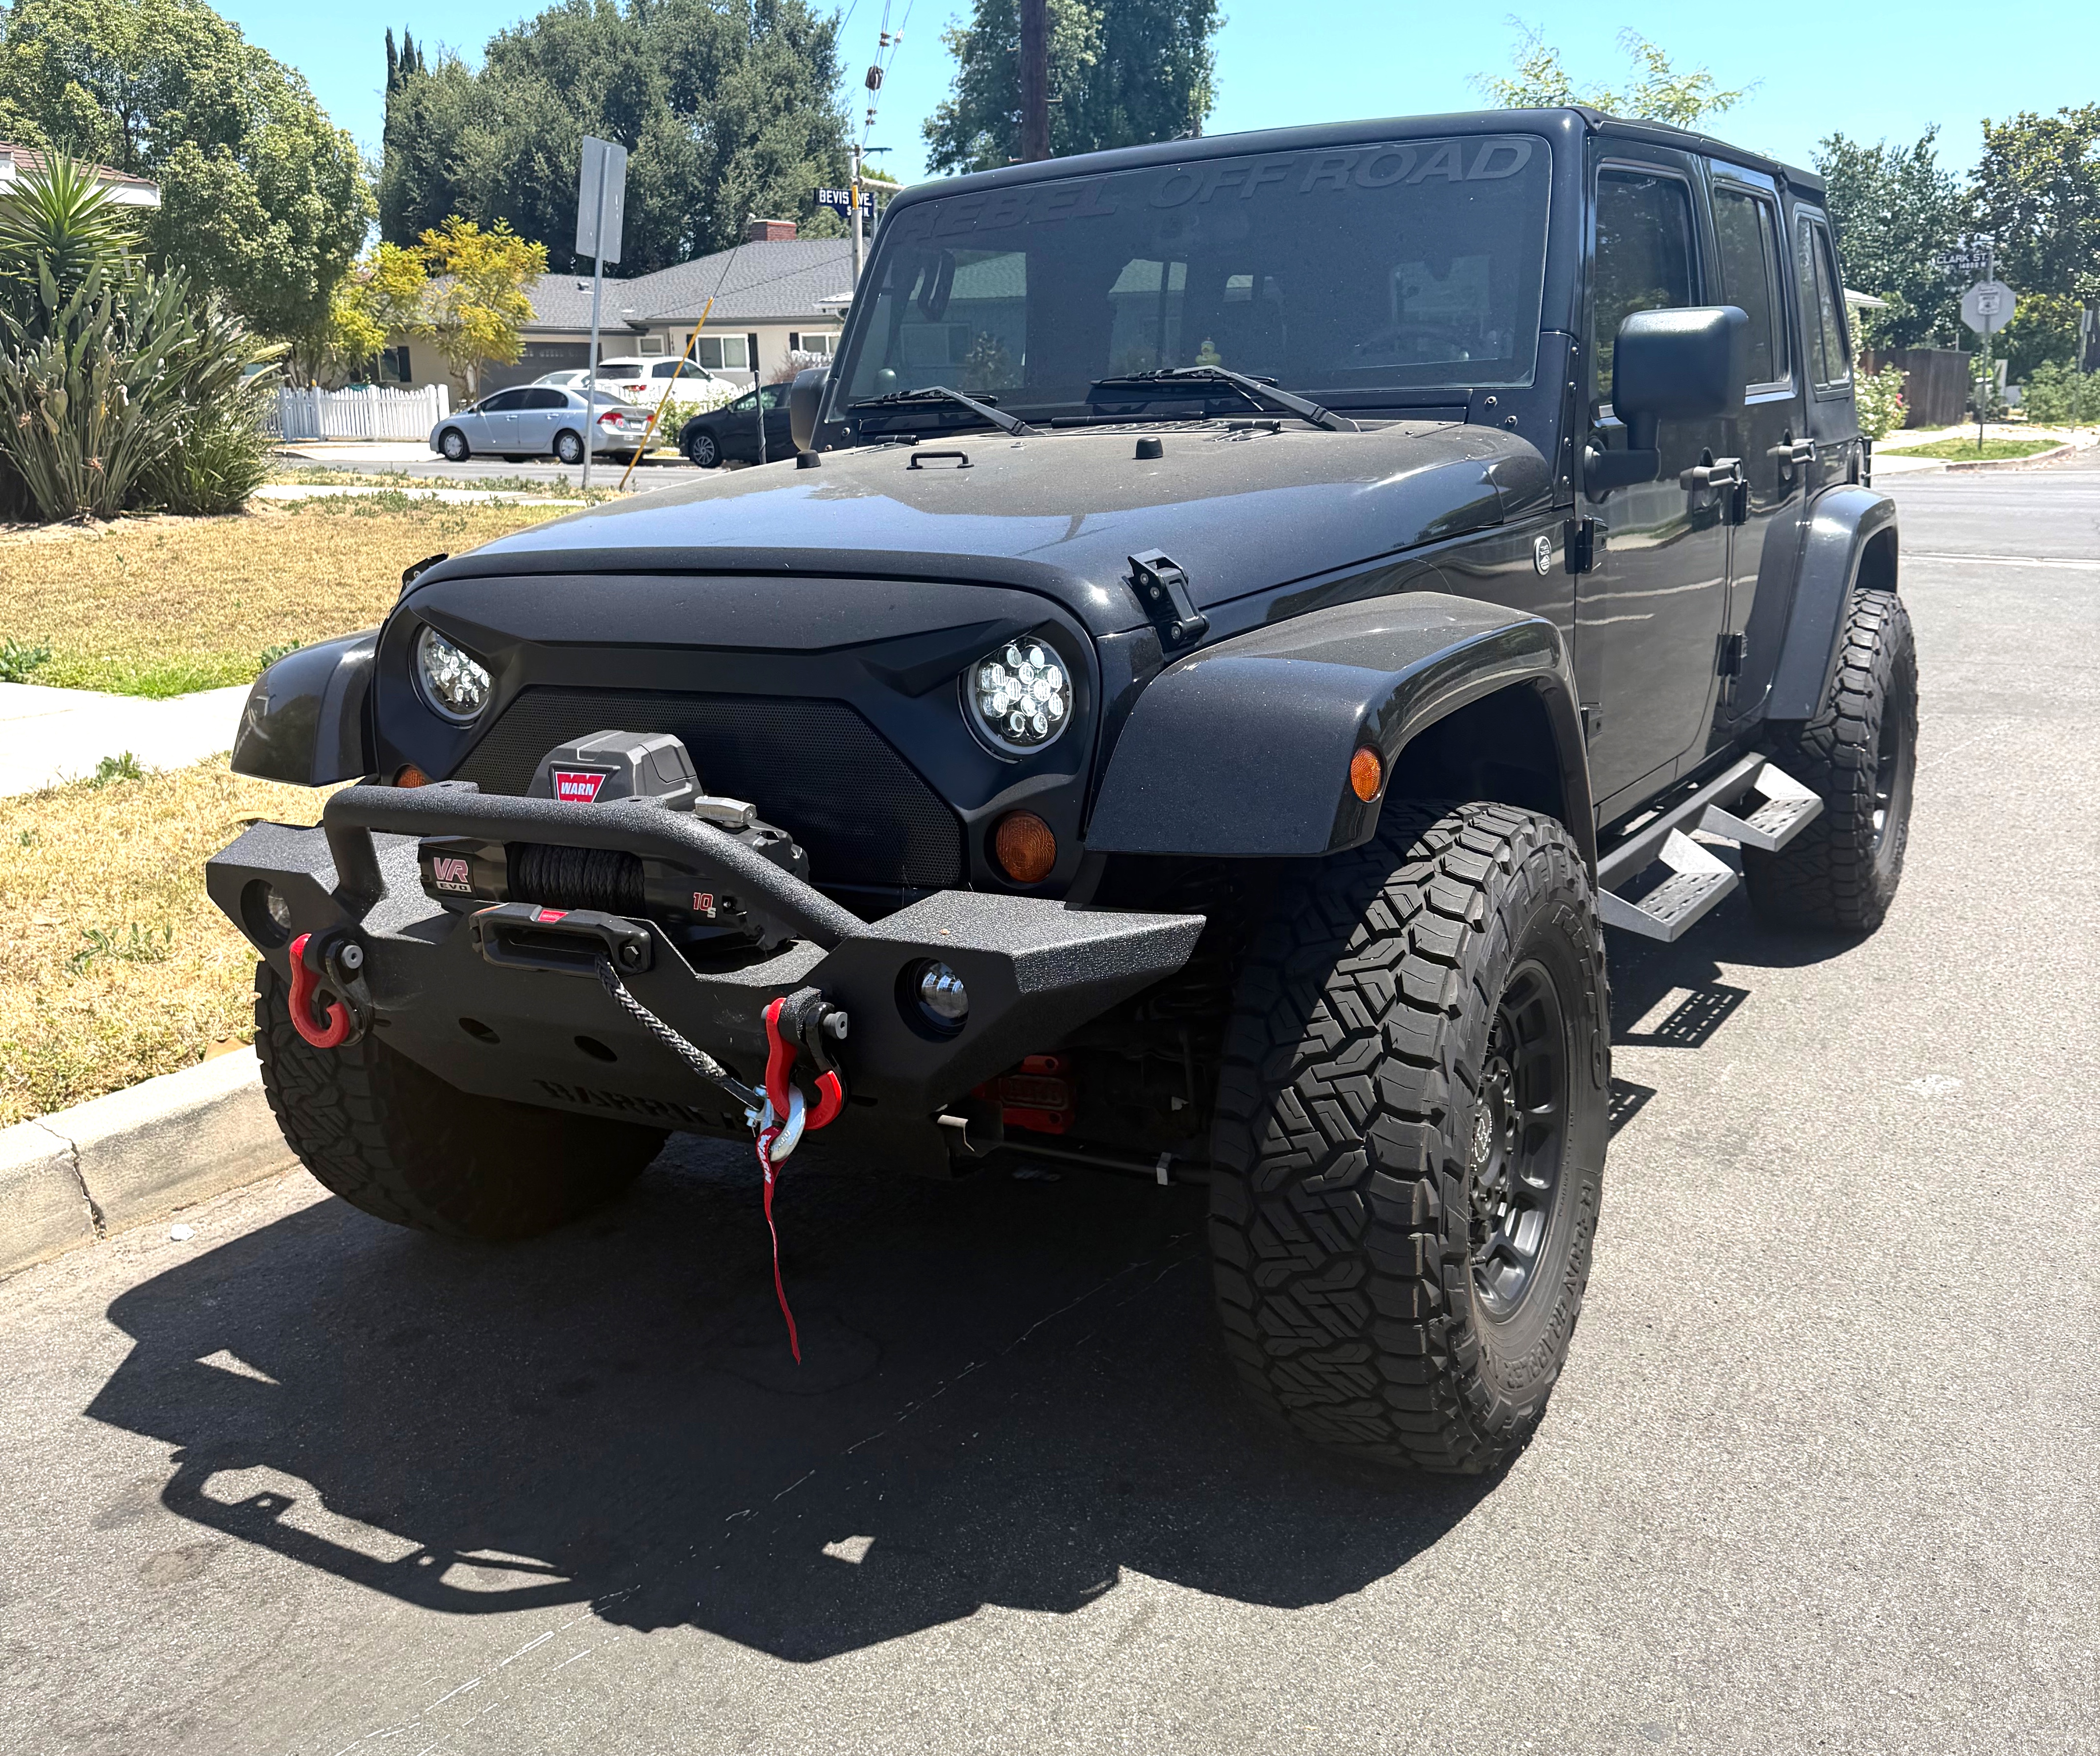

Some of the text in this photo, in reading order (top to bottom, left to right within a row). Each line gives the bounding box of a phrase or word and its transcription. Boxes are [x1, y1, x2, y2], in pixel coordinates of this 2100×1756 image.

[820, 190, 872, 206] BEVIS VE.
[885, 141, 1532, 246] REBEL OFF ROAD
[1936, 254, 1970, 264] CLARK
[561, 782, 594, 795] WARN
[434, 857, 469, 883] VR
[440, 883, 468, 891] EVO
[693, 892, 713, 911] 10
